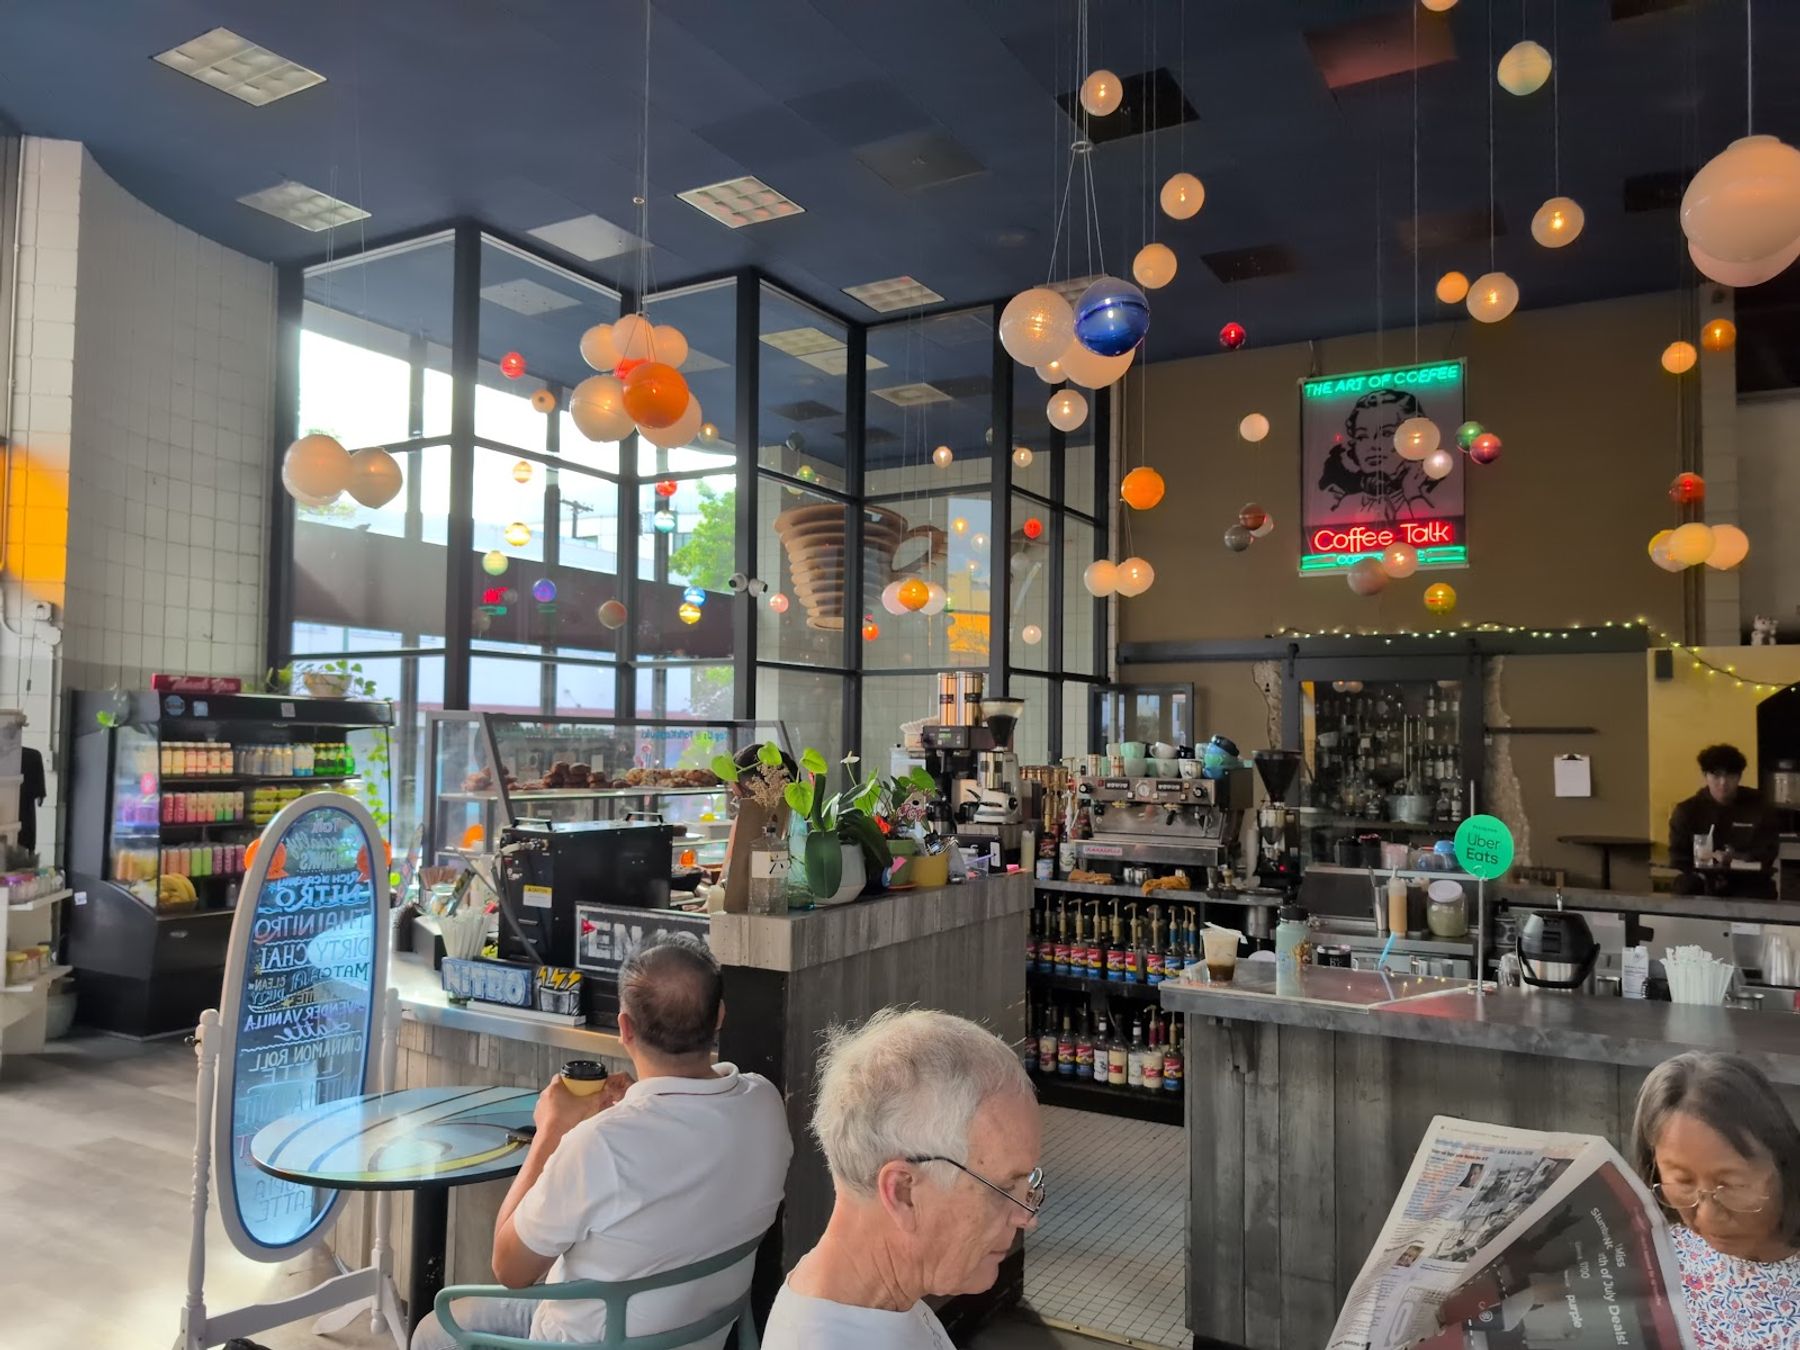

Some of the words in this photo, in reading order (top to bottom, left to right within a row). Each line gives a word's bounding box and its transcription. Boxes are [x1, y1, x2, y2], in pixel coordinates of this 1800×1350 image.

[1304, 381, 1333, 398] THE
[1335, 376, 1366, 393] ART
[1368, 373, 1392, 389] OF
[1314, 526, 1393, 553] Coffee
[1399, 521, 1450, 544] Talk
[1467, 832, 1501, 850] Uber
[1466, 848, 1499, 865] Eats
[1600, 1269, 1613, 1280] of
[1603, 1280, 1617, 1302] July
[1565, 1293, 1584, 1329] purple
[1608, 1304, 1629, 1346] Deals!
